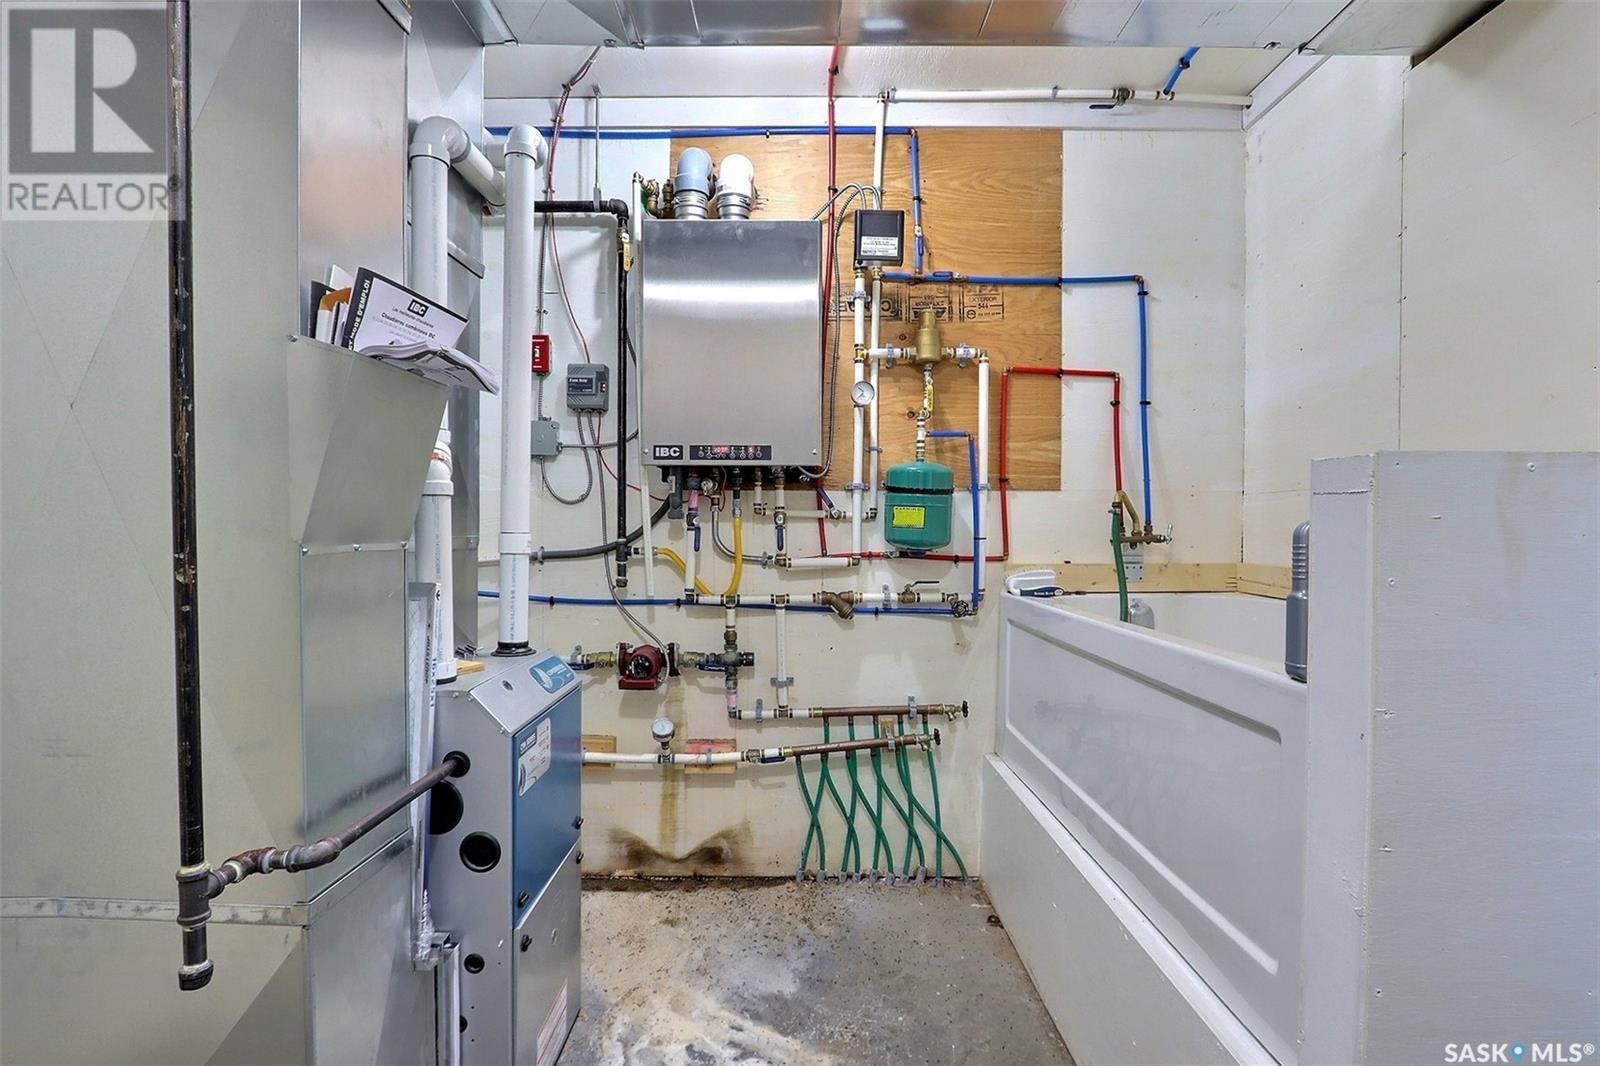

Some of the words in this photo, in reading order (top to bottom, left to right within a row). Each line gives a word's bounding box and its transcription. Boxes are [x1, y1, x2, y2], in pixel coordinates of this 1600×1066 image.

[350, 317, 361, 339] MODE
[357, 279, 371, 316] D'EMPLOI
[410, 301, 426, 314] IBC
[655, 446, 680, 457] IBC
